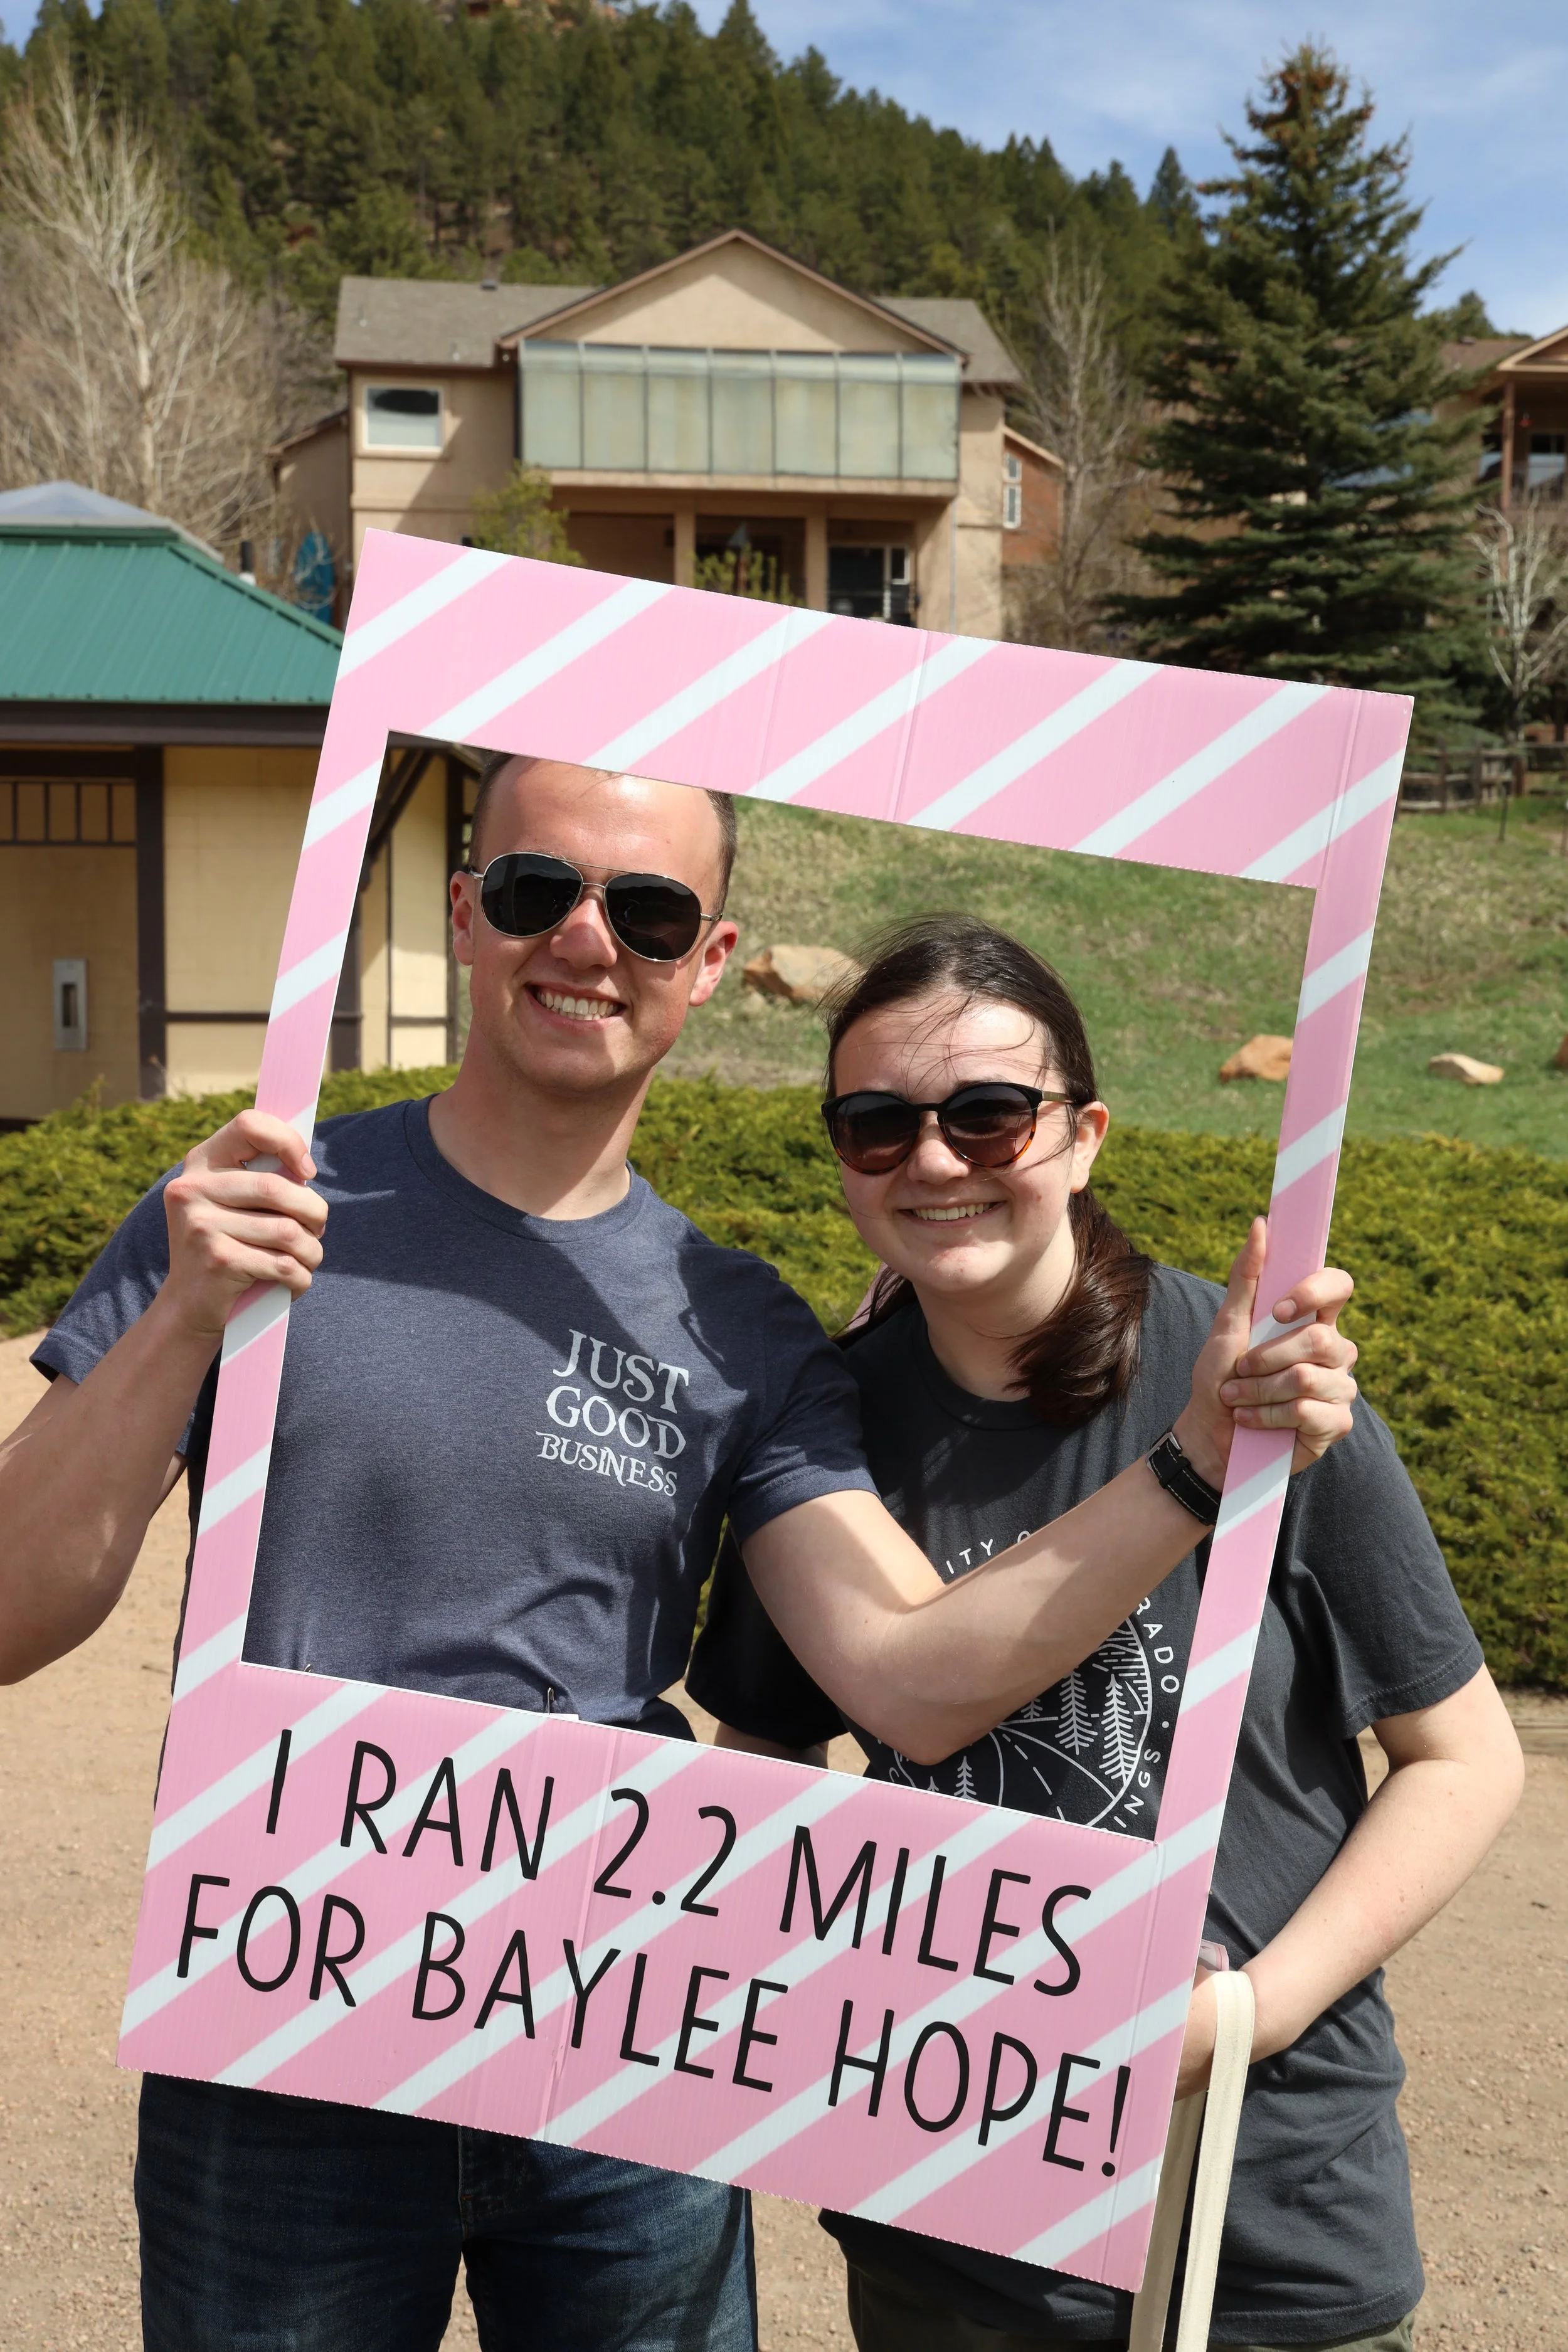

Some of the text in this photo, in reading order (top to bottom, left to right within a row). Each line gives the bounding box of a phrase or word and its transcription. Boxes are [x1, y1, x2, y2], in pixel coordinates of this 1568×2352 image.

[552, 1328, 690, 1414] JUST
[535, 1431, 678, 1497] BUSINESS
[545, 1385, 687, 1459] GOOD
[265, 1729, 1092, 1997] I RAN 2.2 MILES
[176, 1873, 1132, 2178] FOR BAYLEE HOPE!
